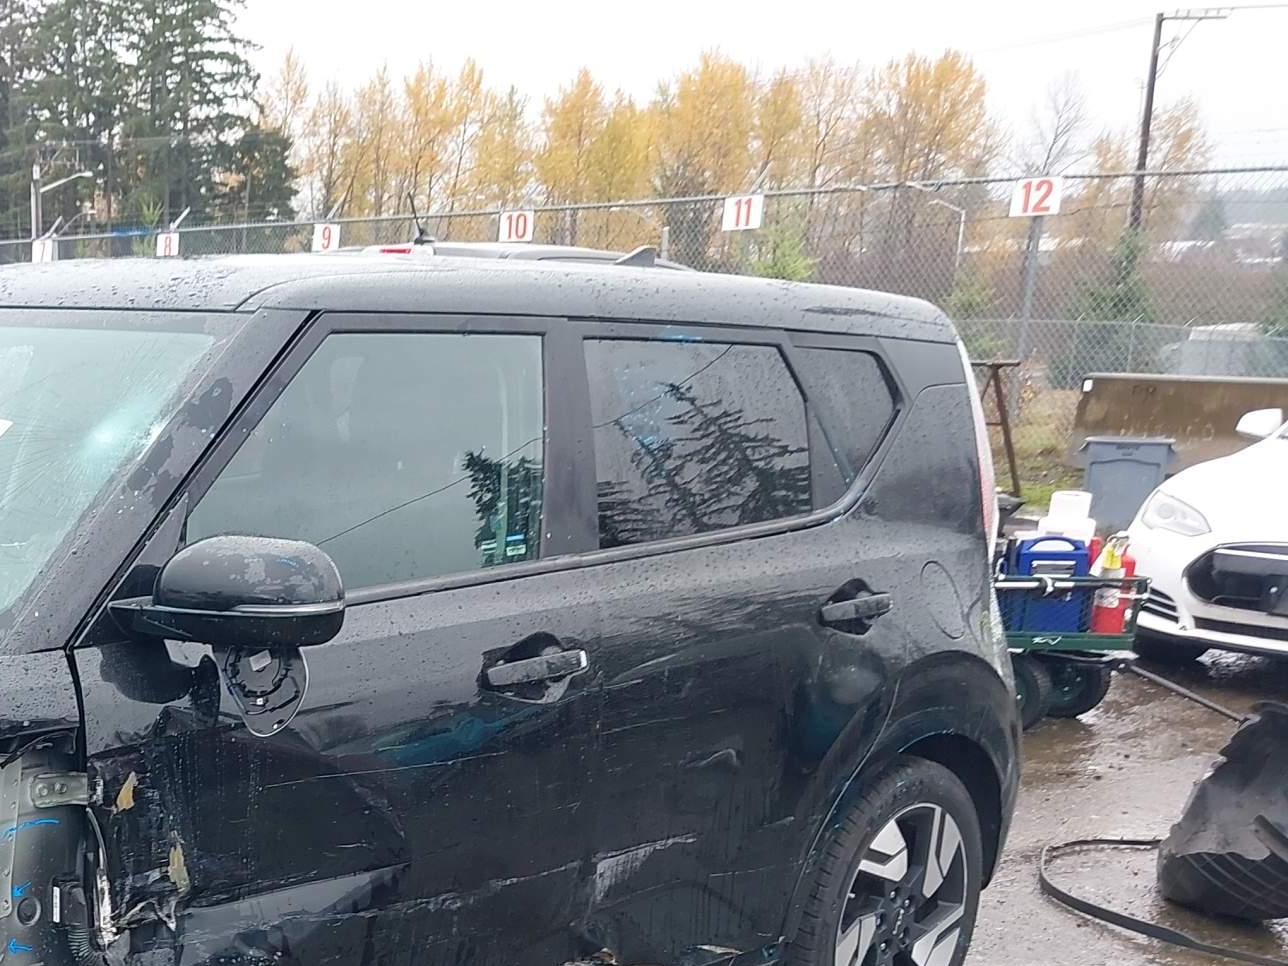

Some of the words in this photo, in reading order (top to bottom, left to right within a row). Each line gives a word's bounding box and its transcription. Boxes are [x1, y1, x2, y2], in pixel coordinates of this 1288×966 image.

[1021, 179, 1054, 214] 12
[507, 213, 527, 240] 10
[734, 197, 753, 228] 11
[322, 225, 332, 249] 9
